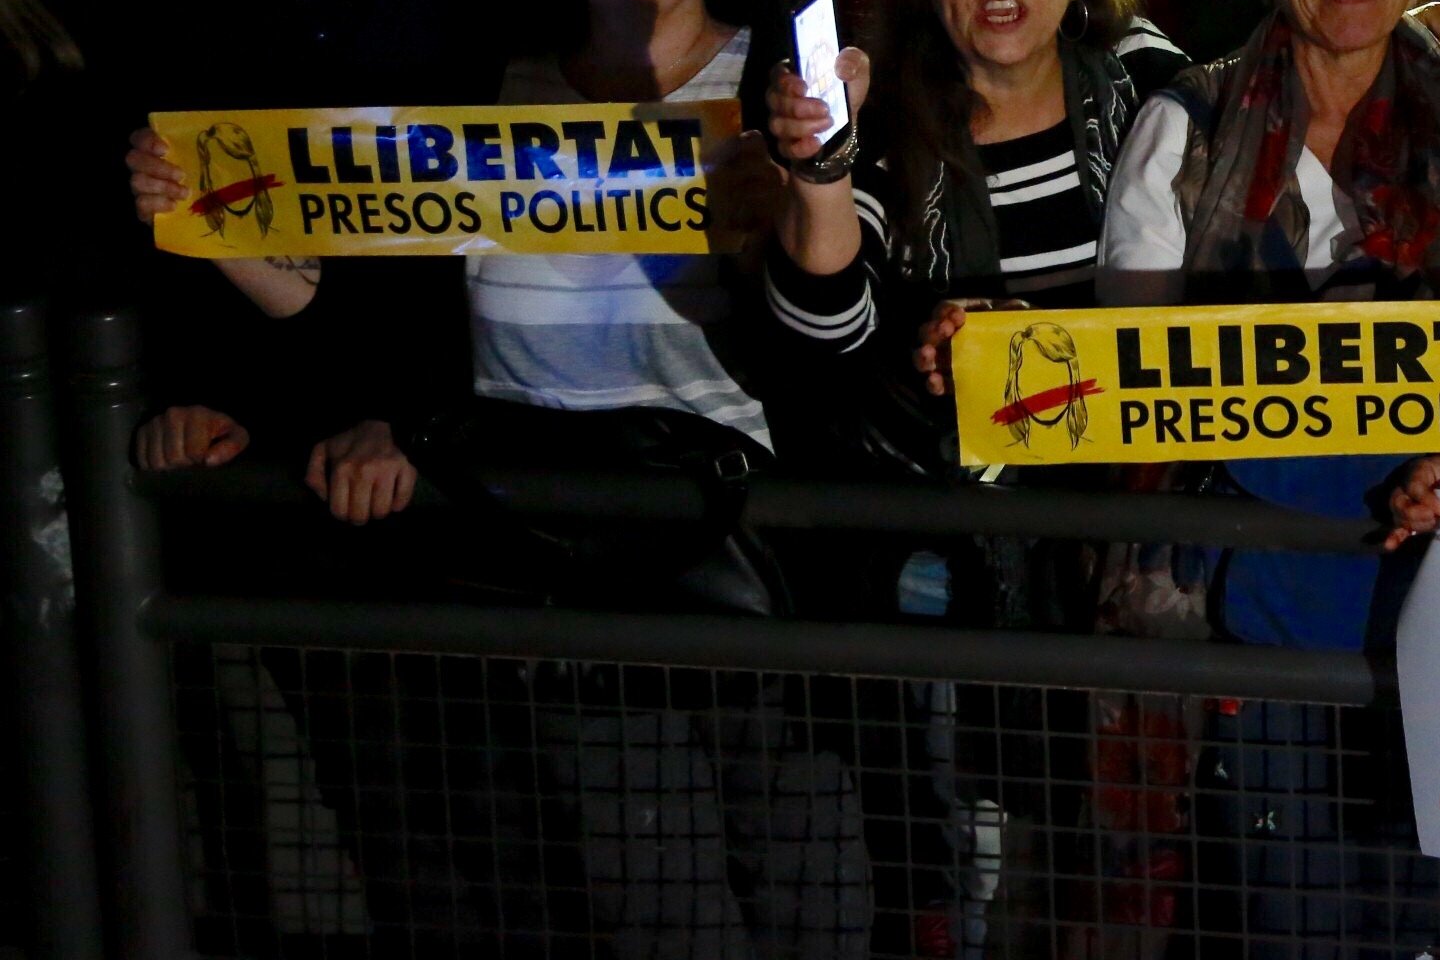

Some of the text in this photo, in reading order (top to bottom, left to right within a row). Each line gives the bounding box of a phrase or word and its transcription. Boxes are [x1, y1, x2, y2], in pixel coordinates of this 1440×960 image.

[286, 118, 703, 184] LLIBERTAT
[300, 178, 711, 235] PRESOS POLÍTICS
[1121, 393, 1332, 444] PRESOS
